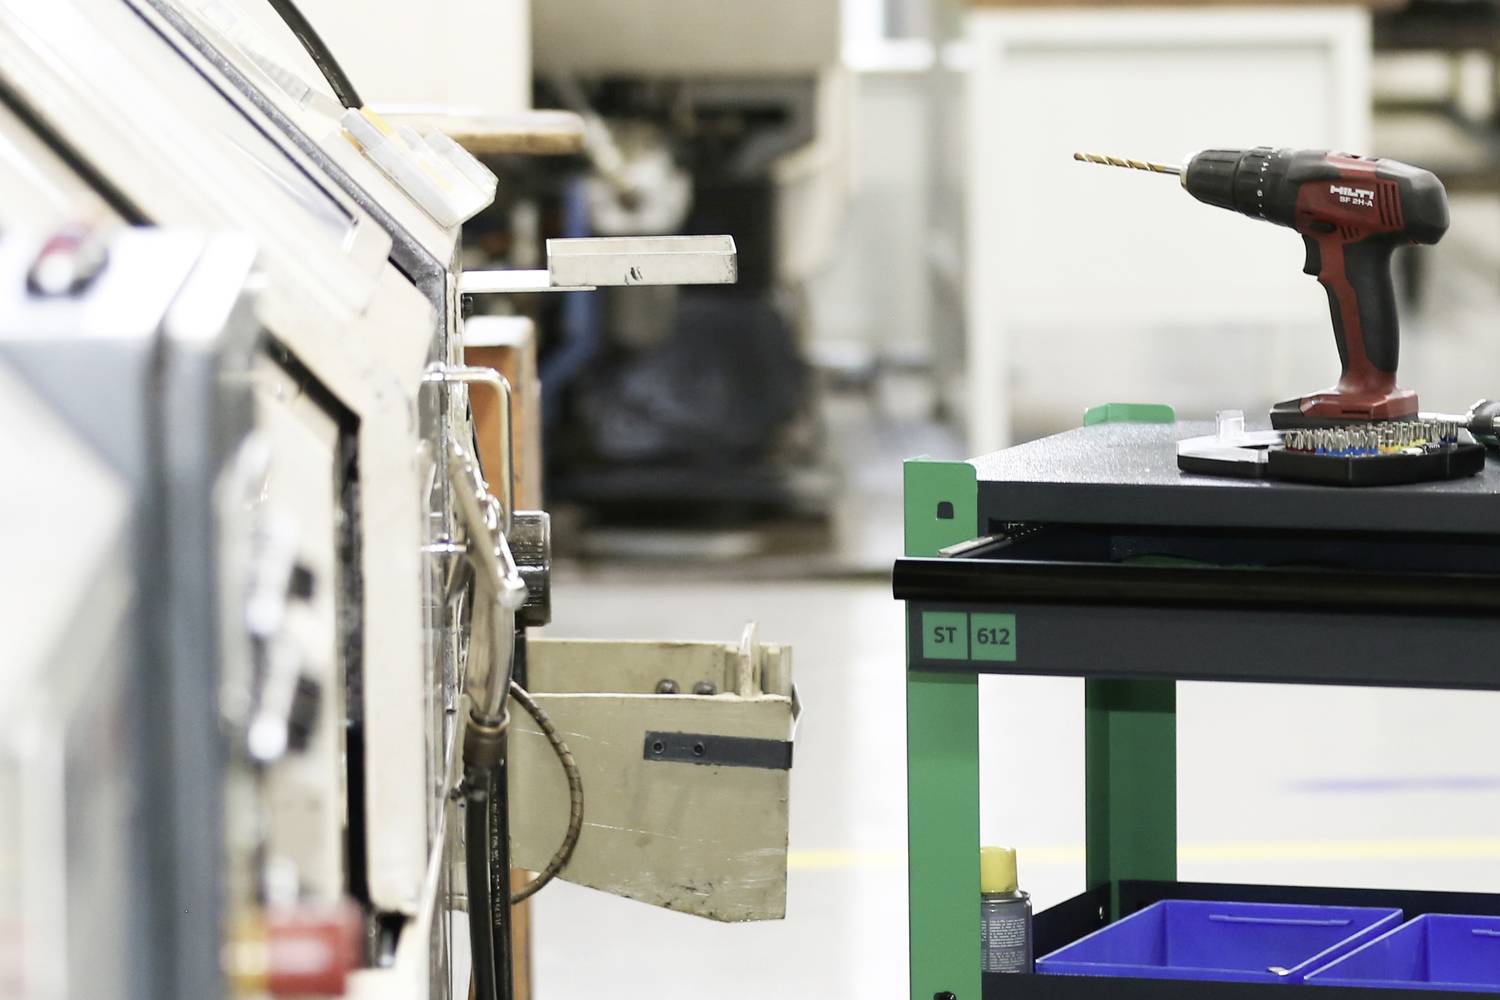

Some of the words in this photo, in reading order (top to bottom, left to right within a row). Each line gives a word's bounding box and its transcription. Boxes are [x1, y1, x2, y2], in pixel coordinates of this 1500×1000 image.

[1330, 185, 1375, 200] HILTI
[933, 626, 957, 644] ST
[977, 627, 1010, 646] 612
